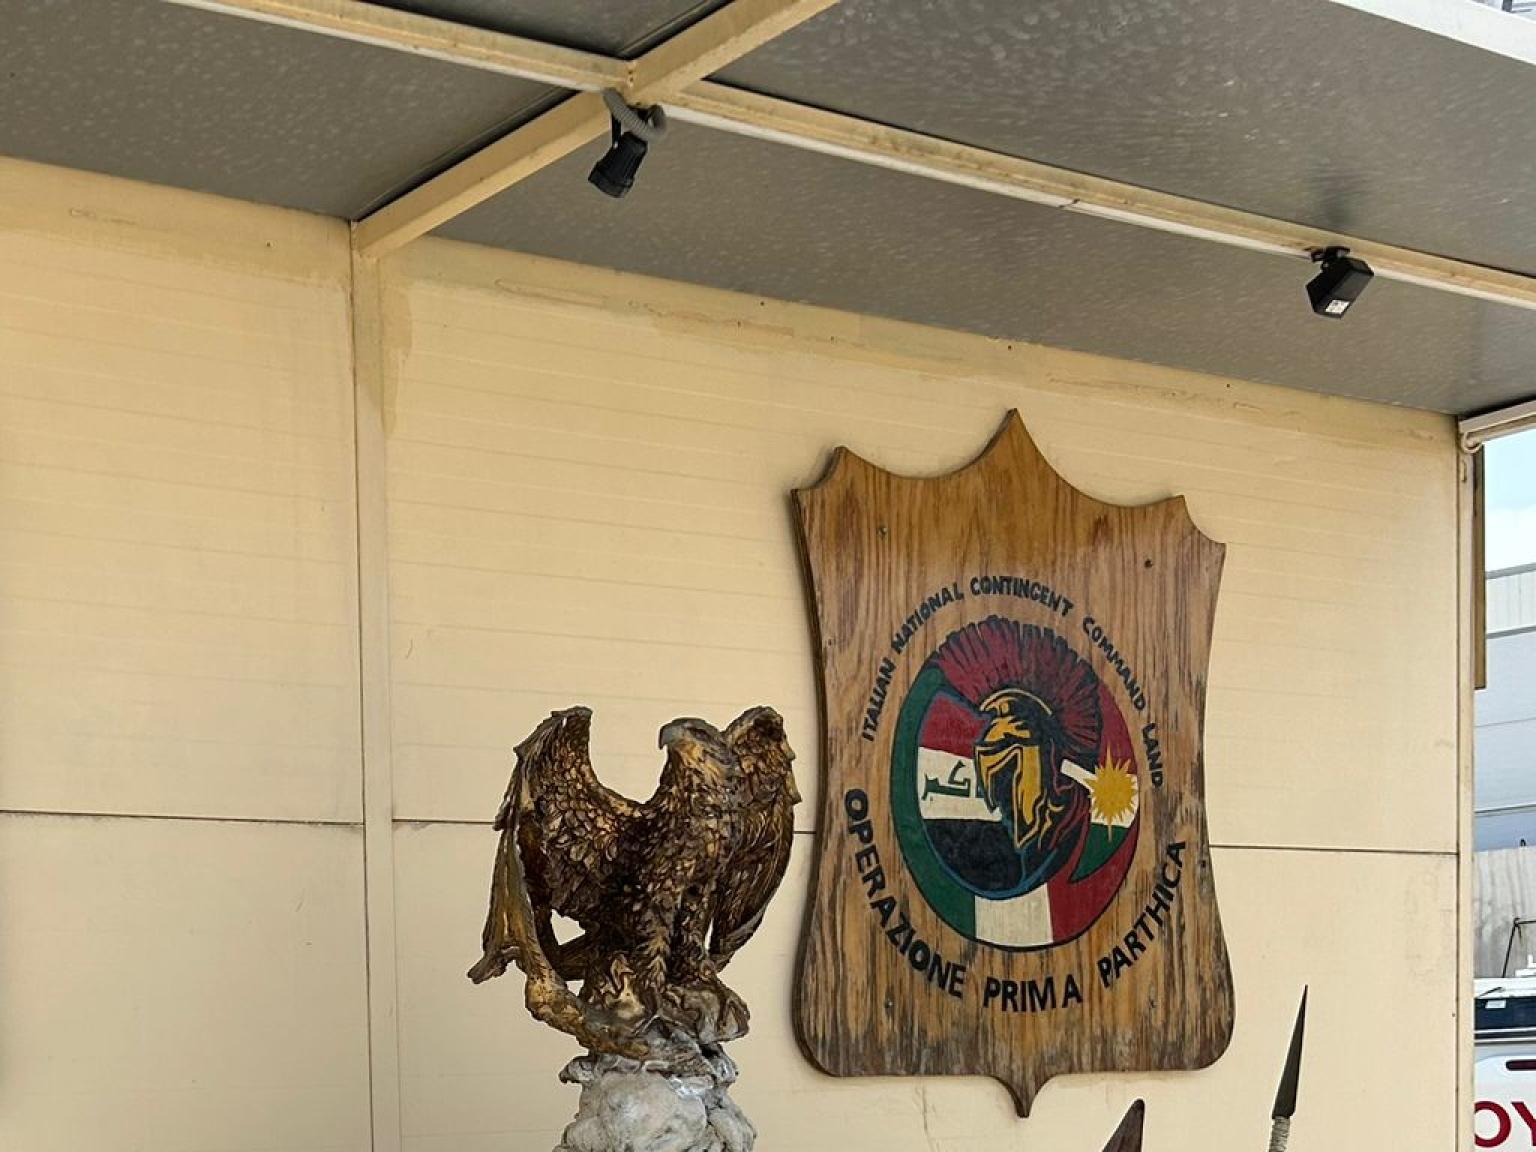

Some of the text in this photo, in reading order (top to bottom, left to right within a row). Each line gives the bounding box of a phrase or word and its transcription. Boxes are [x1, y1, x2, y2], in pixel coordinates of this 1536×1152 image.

[862, 575, 1163, 787] ITALIAN NATIONAL CONTINGENT COMMAND LAND
[844, 788, 1186, 1013] OPERAZIONE PRIMA PARTHICA
